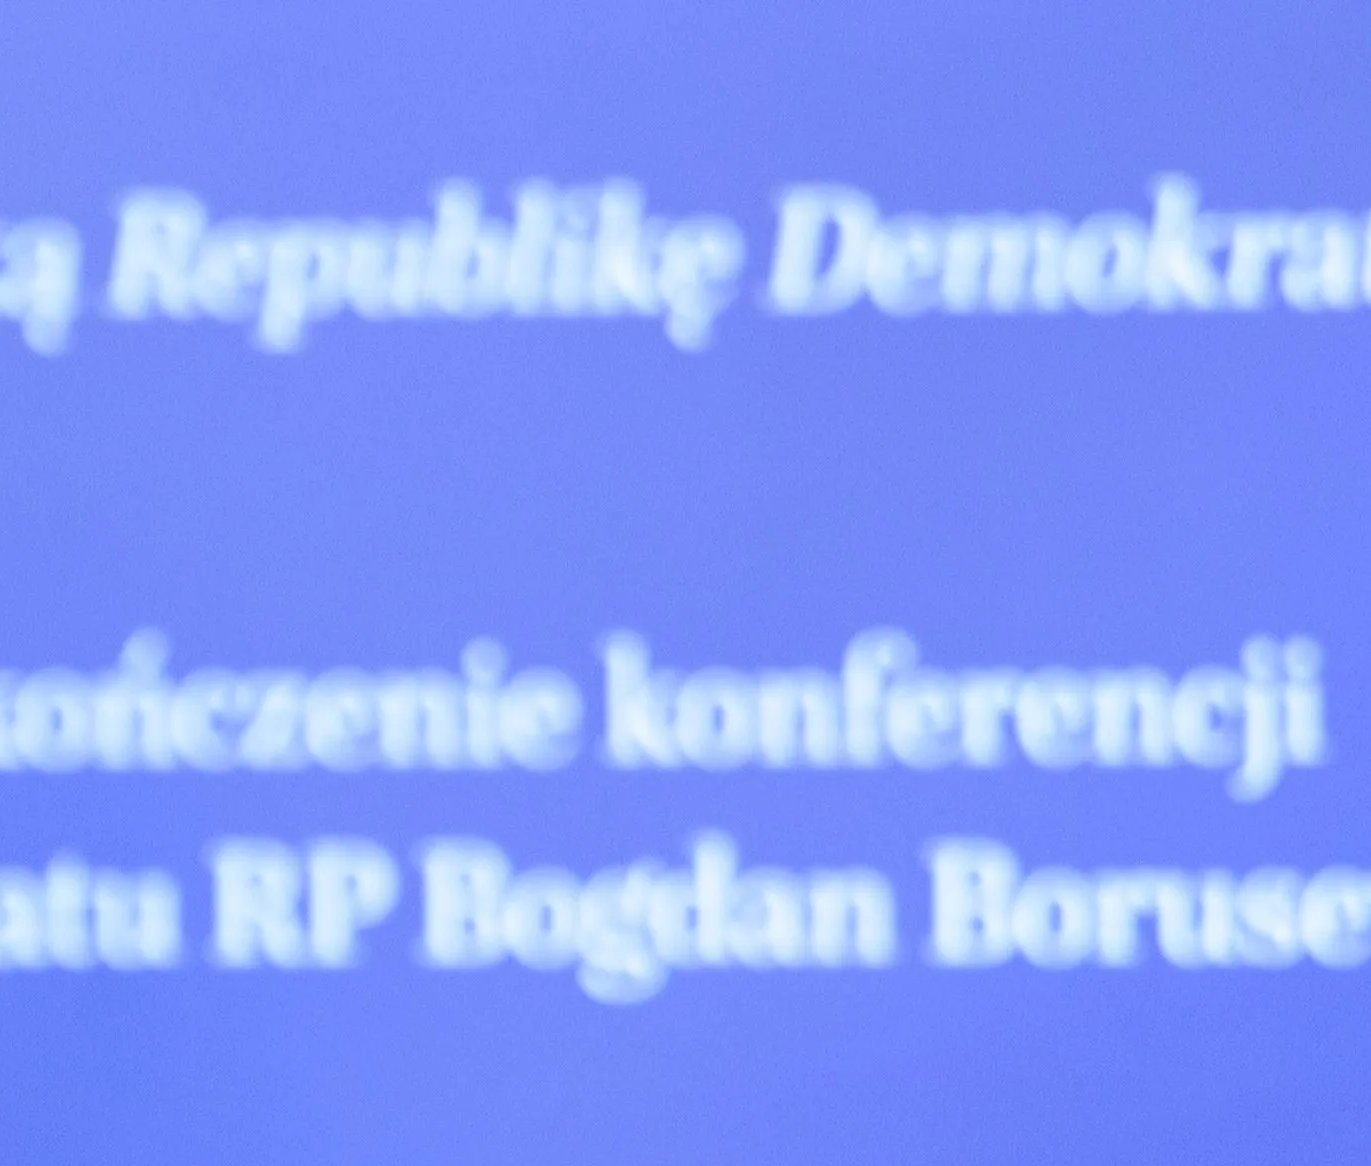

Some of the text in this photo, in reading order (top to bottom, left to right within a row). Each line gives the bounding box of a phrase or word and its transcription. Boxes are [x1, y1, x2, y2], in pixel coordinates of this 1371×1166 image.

[105, 182, 748, 352] Republikę
[600, 626, 1324, 800] konferencji
[208, 838, 402, 970] RP
[418, 830, 898, 1006] Bogdan
